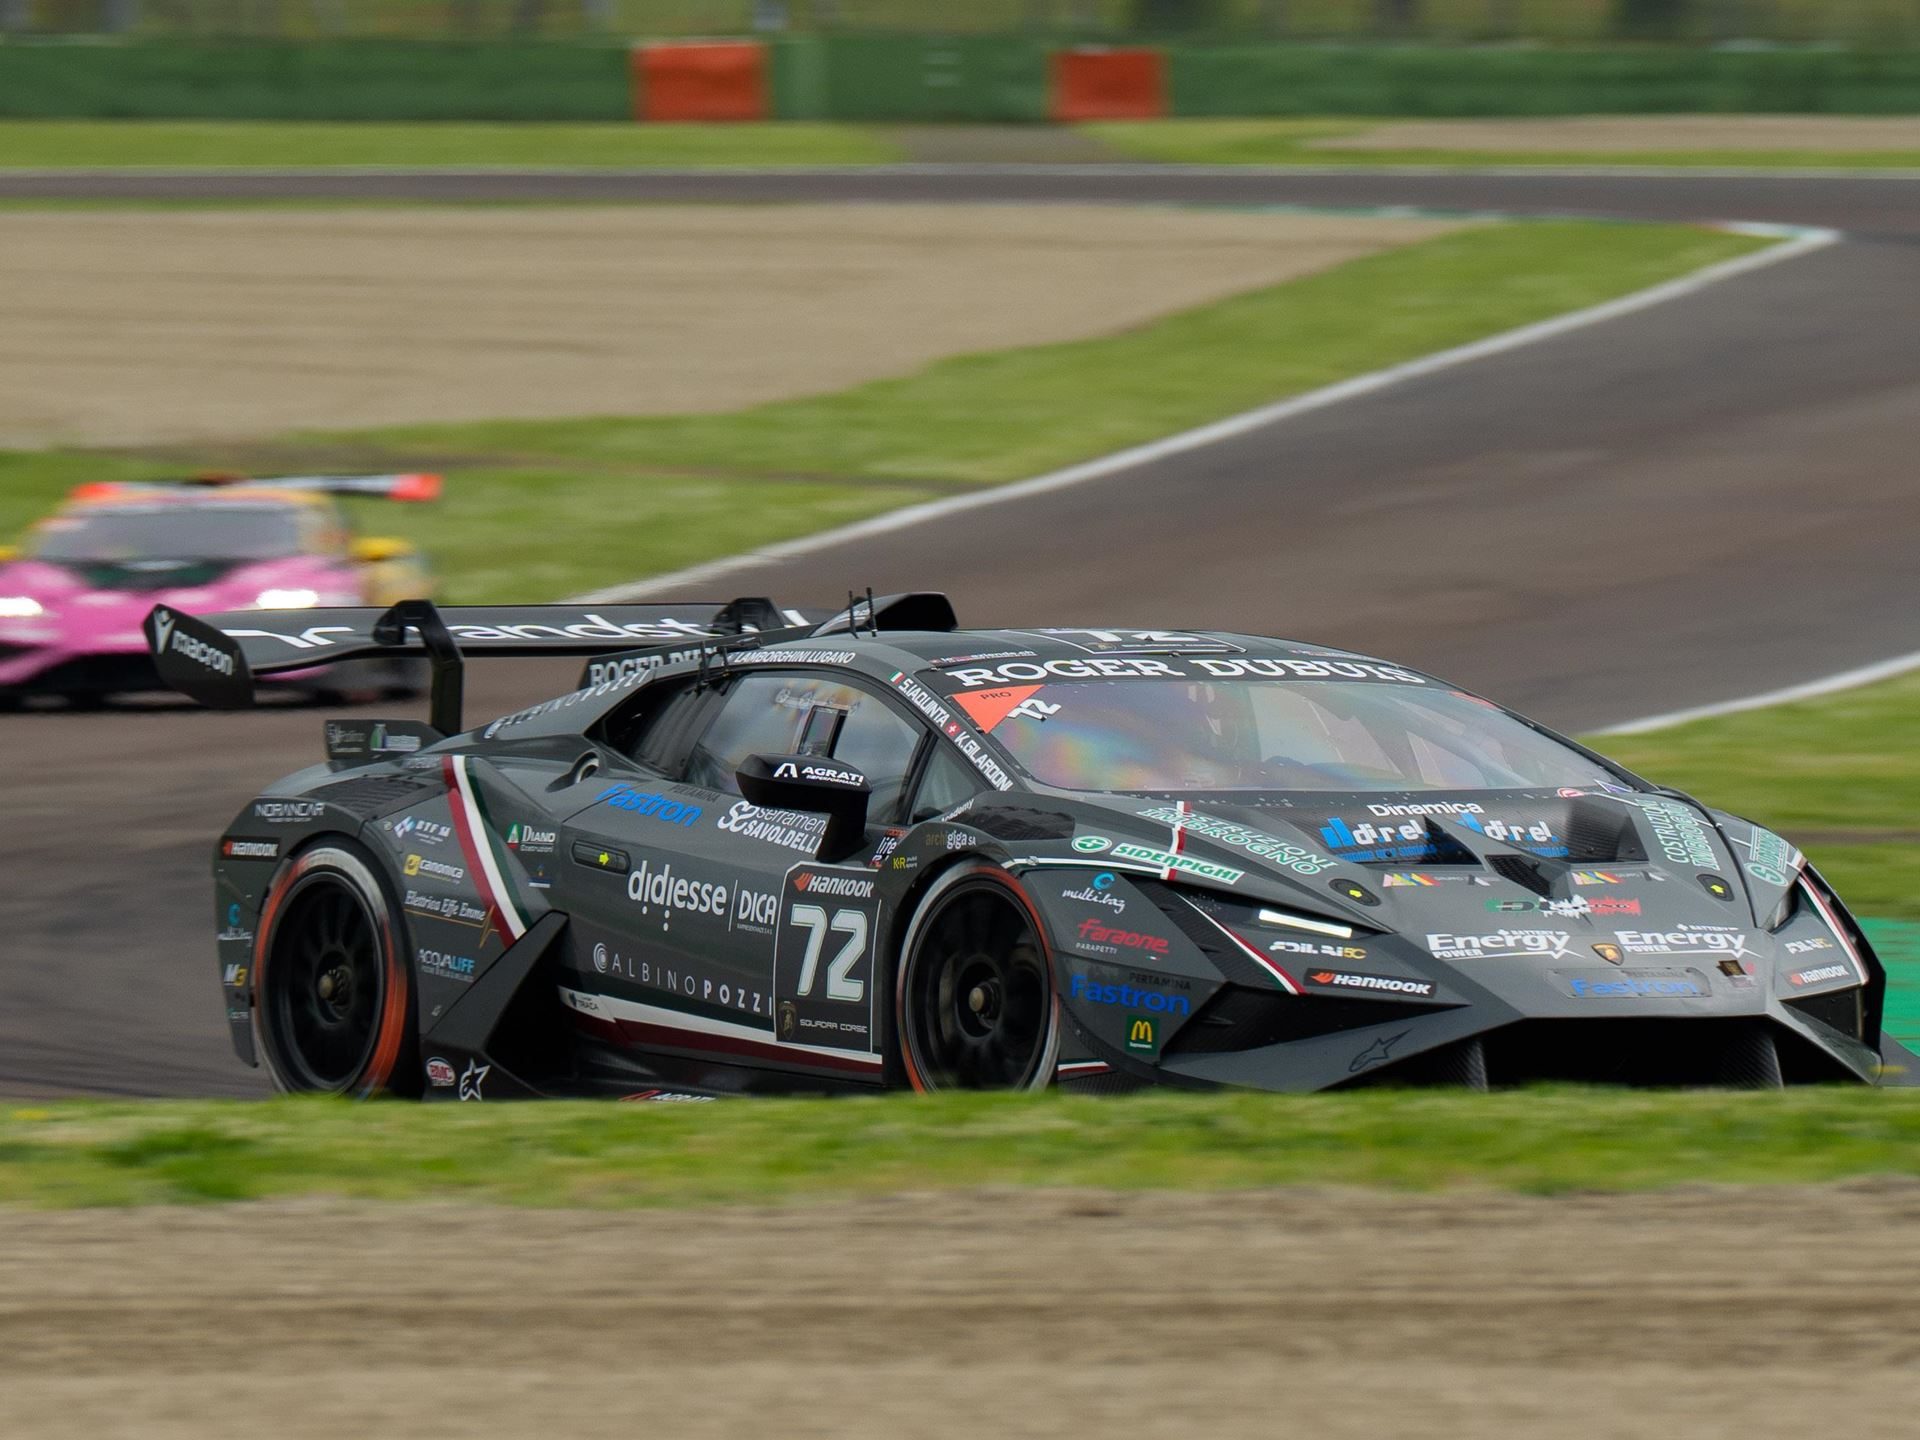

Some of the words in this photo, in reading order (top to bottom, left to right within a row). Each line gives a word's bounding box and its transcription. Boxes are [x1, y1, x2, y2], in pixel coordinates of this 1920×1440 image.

[171, 629, 233, 676] macron
[734, 650, 808, 664] LAMBORGHINI
[808, 651, 857, 664] LUGANO
[945, 659, 1187, 687] ROGER
[1190, 659, 1425, 684] DUBUIS
[980, 691, 1012, 700] PRO
[953, 732, 1014, 791] K.GILARDONI
[801, 766, 864, 783] AGRATI
[595, 783, 703, 828] Fastron
[1366, 801, 1485, 817] Dinamica
[756, 807, 827, 836] serramen
[738, 889, 778, 925] DICA
[1075, 942, 1119, 955] PARAPETTI
[1425, 933, 1571, 951] Energy
[1614, 930, 1746, 951] Energy
[1624, 944, 1672, 953] POWER
[790, 903, 868, 1003] 72
[1432, 948, 1485, 959] POWER
[1070, 973, 1192, 1017] Fastron
[1569, 978, 1698, 997] Fastron
[800, 1018, 838, 1030] SQUADRA
[840, 1023, 868, 1033] CORSE
